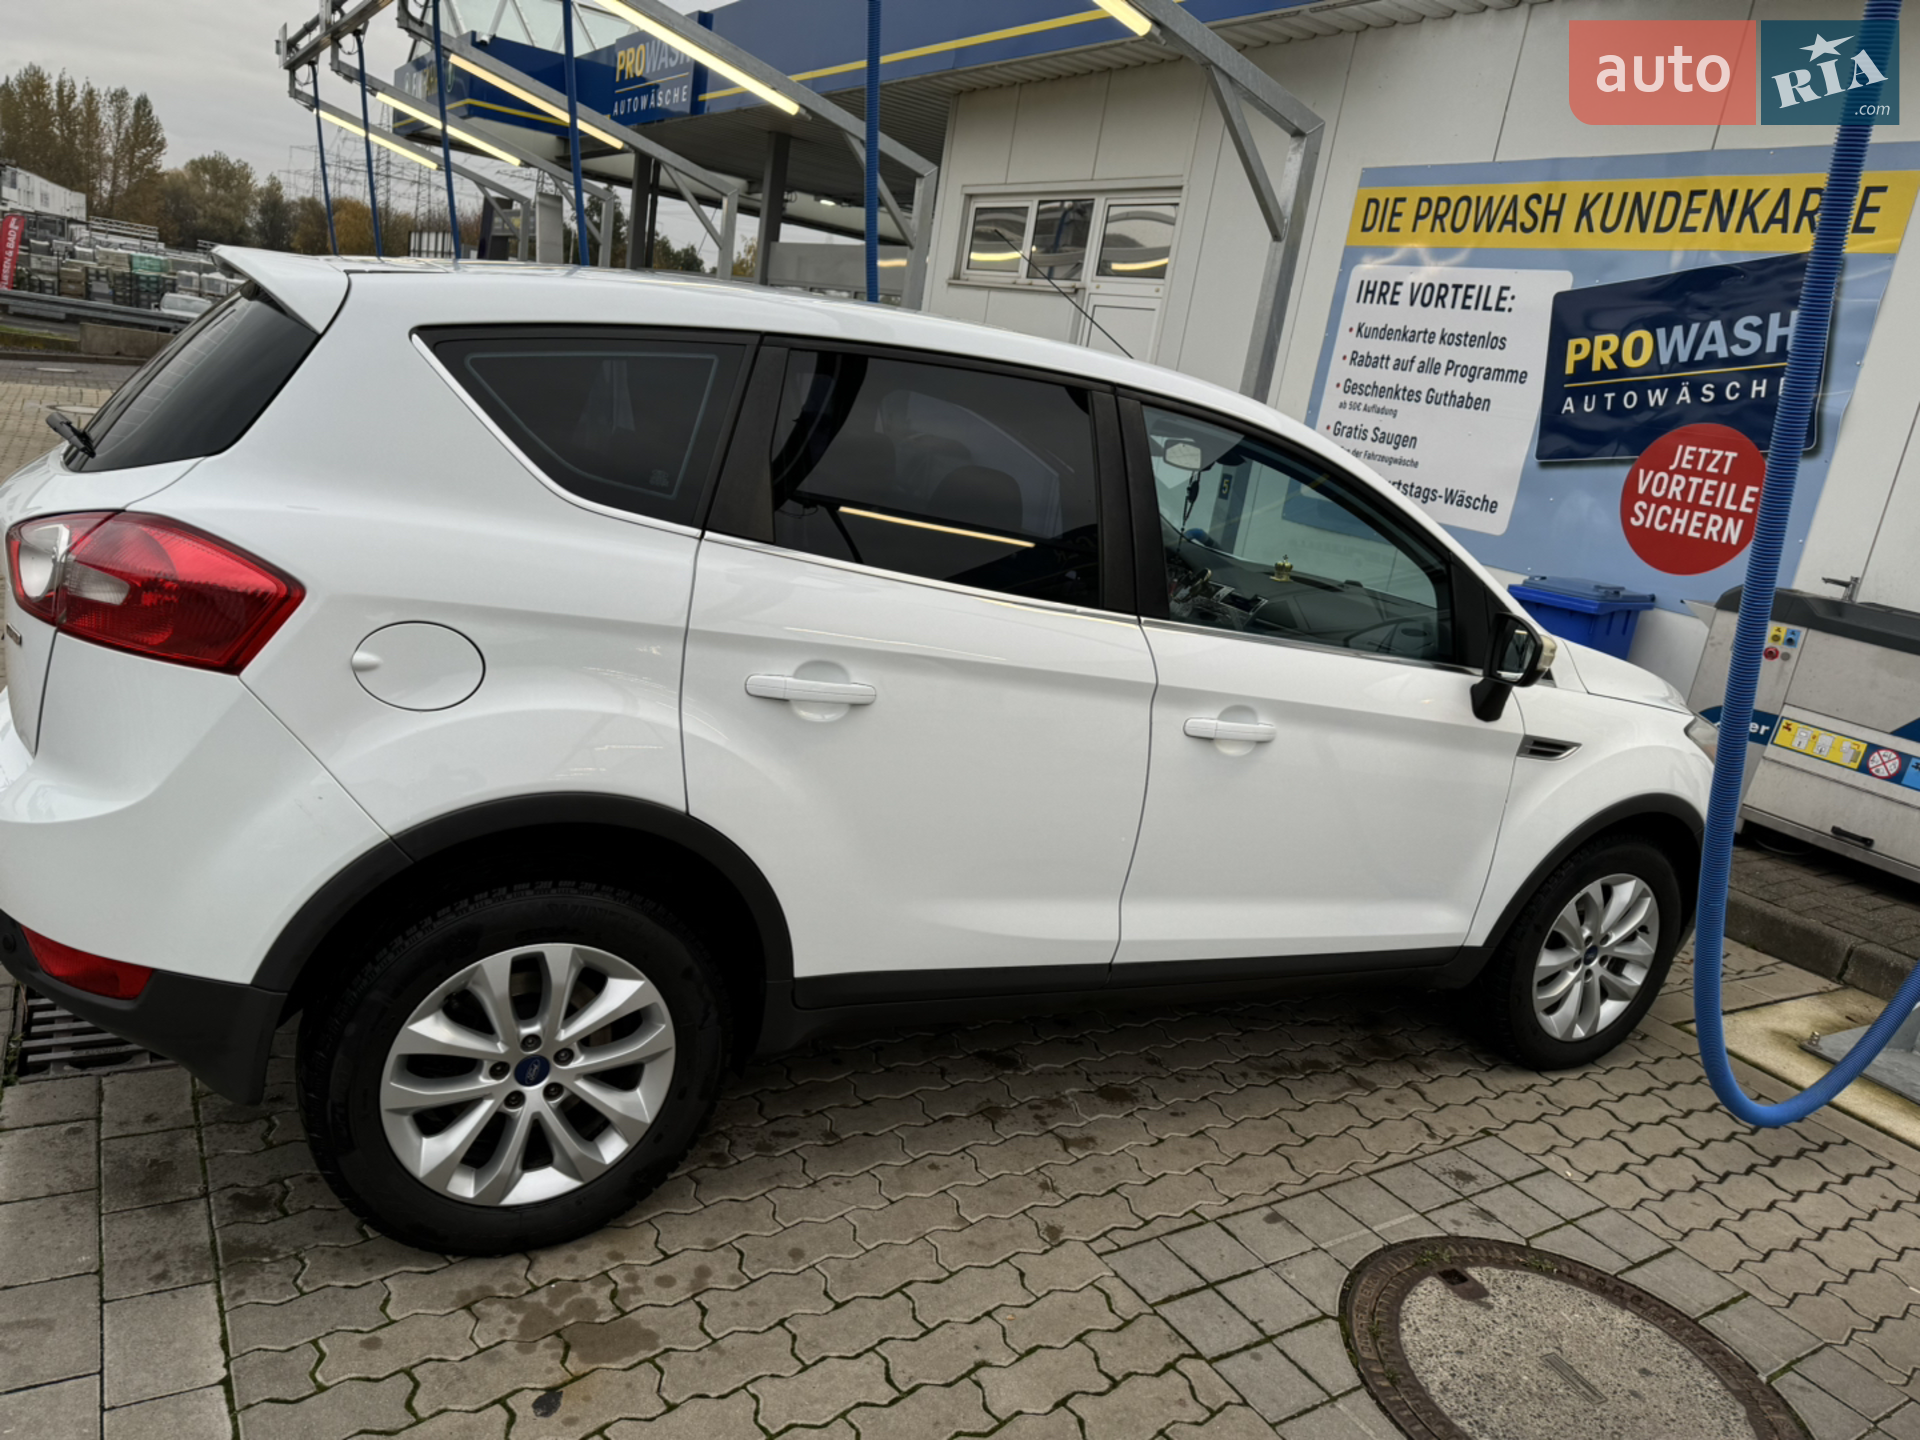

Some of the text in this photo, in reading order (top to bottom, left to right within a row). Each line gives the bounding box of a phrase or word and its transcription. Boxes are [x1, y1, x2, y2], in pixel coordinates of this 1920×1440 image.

[616, 39, 690, 82] PROWAS
[613, 85, 688, 116] AUTOWÄSCHE
[1361, 185, 1889, 235] DIE PROWASH KUNDENKARE
[1356, 279, 1516, 313] IHRE VORTEILE:
[1355, 321, 1508, 351] Kundenkarte kostenlos
[1565, 310, 1800, 375] PROWASH
[1348, 350, 1528, 385] Rabatt auf alle Programme
[1338, 400, 1399, 419] ab 50€ Aufladung
[1343, 378, 1491, 412] Geschenktes Guthaben
[1332, 420, 1418, 450] Gratis Saugen
[1351, 448, 1364, 458] der
[1363, 450, 1420, 469] Fahrzeugwäsche
[1669, 444, 1738, 476] JETZT
[1222, 479, 1229, 494] 5
[1637, 468, 1760, 514] VORTEILE
[1630, 501, 1745, 547] SICHERN
